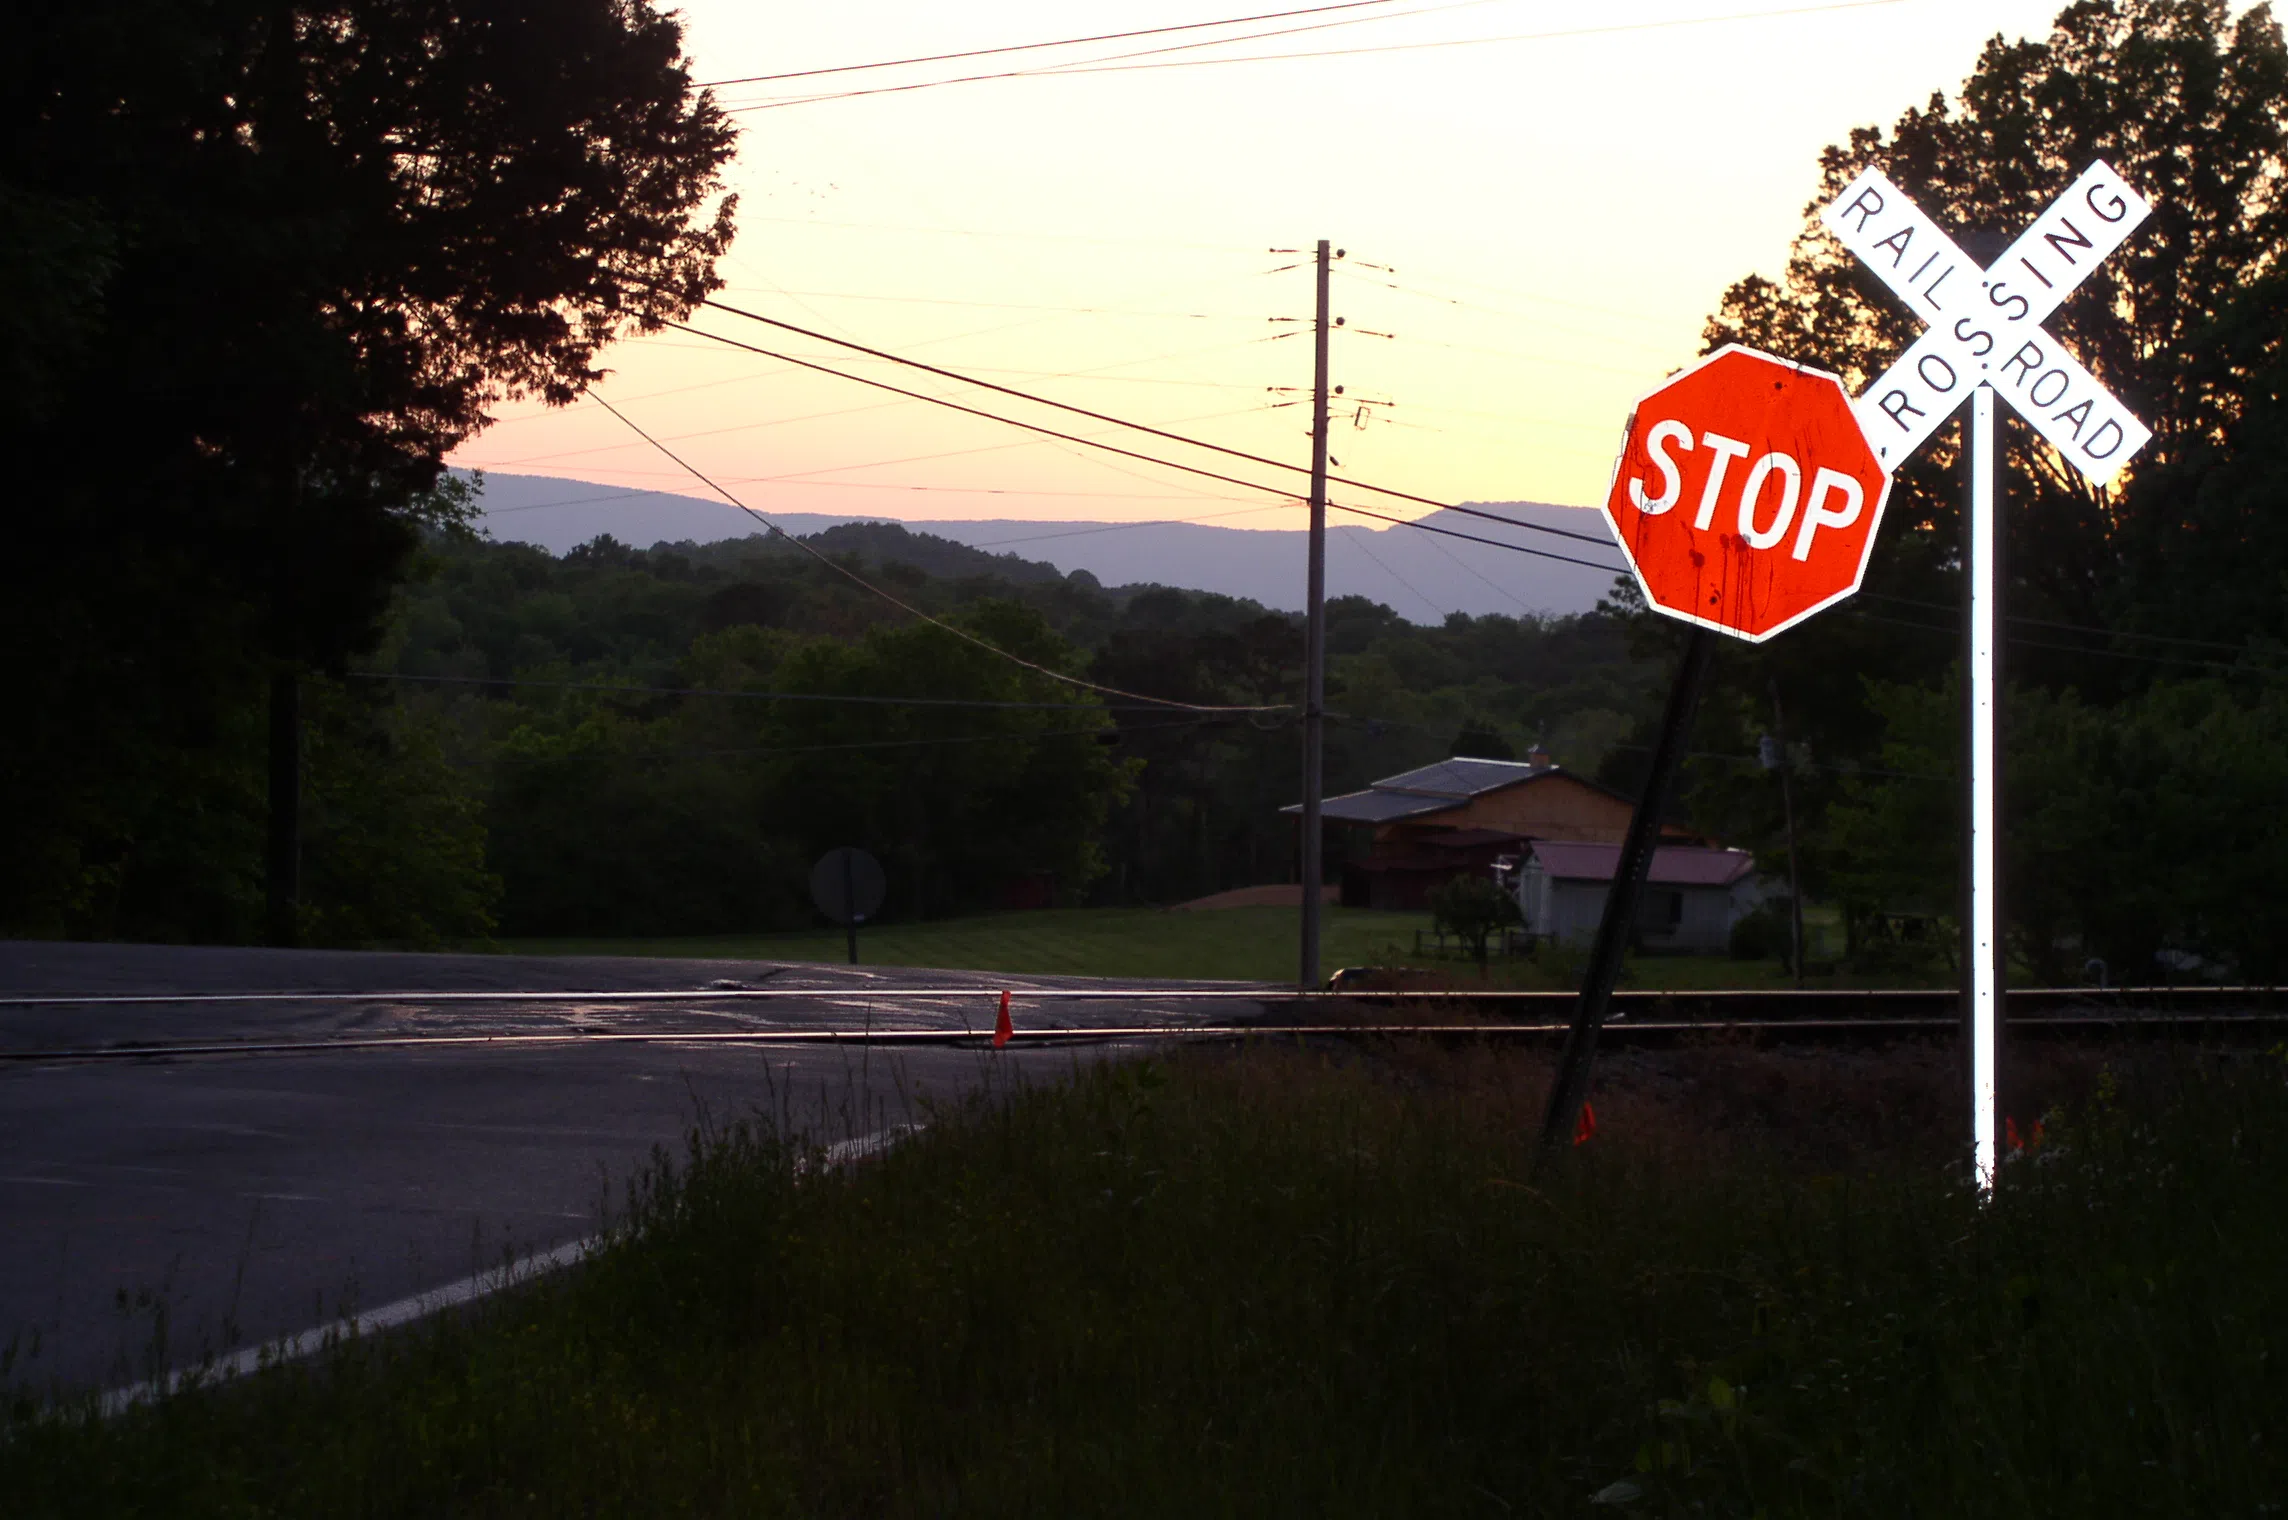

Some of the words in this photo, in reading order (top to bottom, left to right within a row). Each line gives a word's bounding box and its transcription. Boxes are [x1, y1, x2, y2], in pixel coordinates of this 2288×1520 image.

[1841, 186, 1955, 312] RAIL
[2000, 341, 2124, 461] ROAD
[1878, 183, 2128, 458] ROSSING
[1628, 418, 1865, 563] STOP
